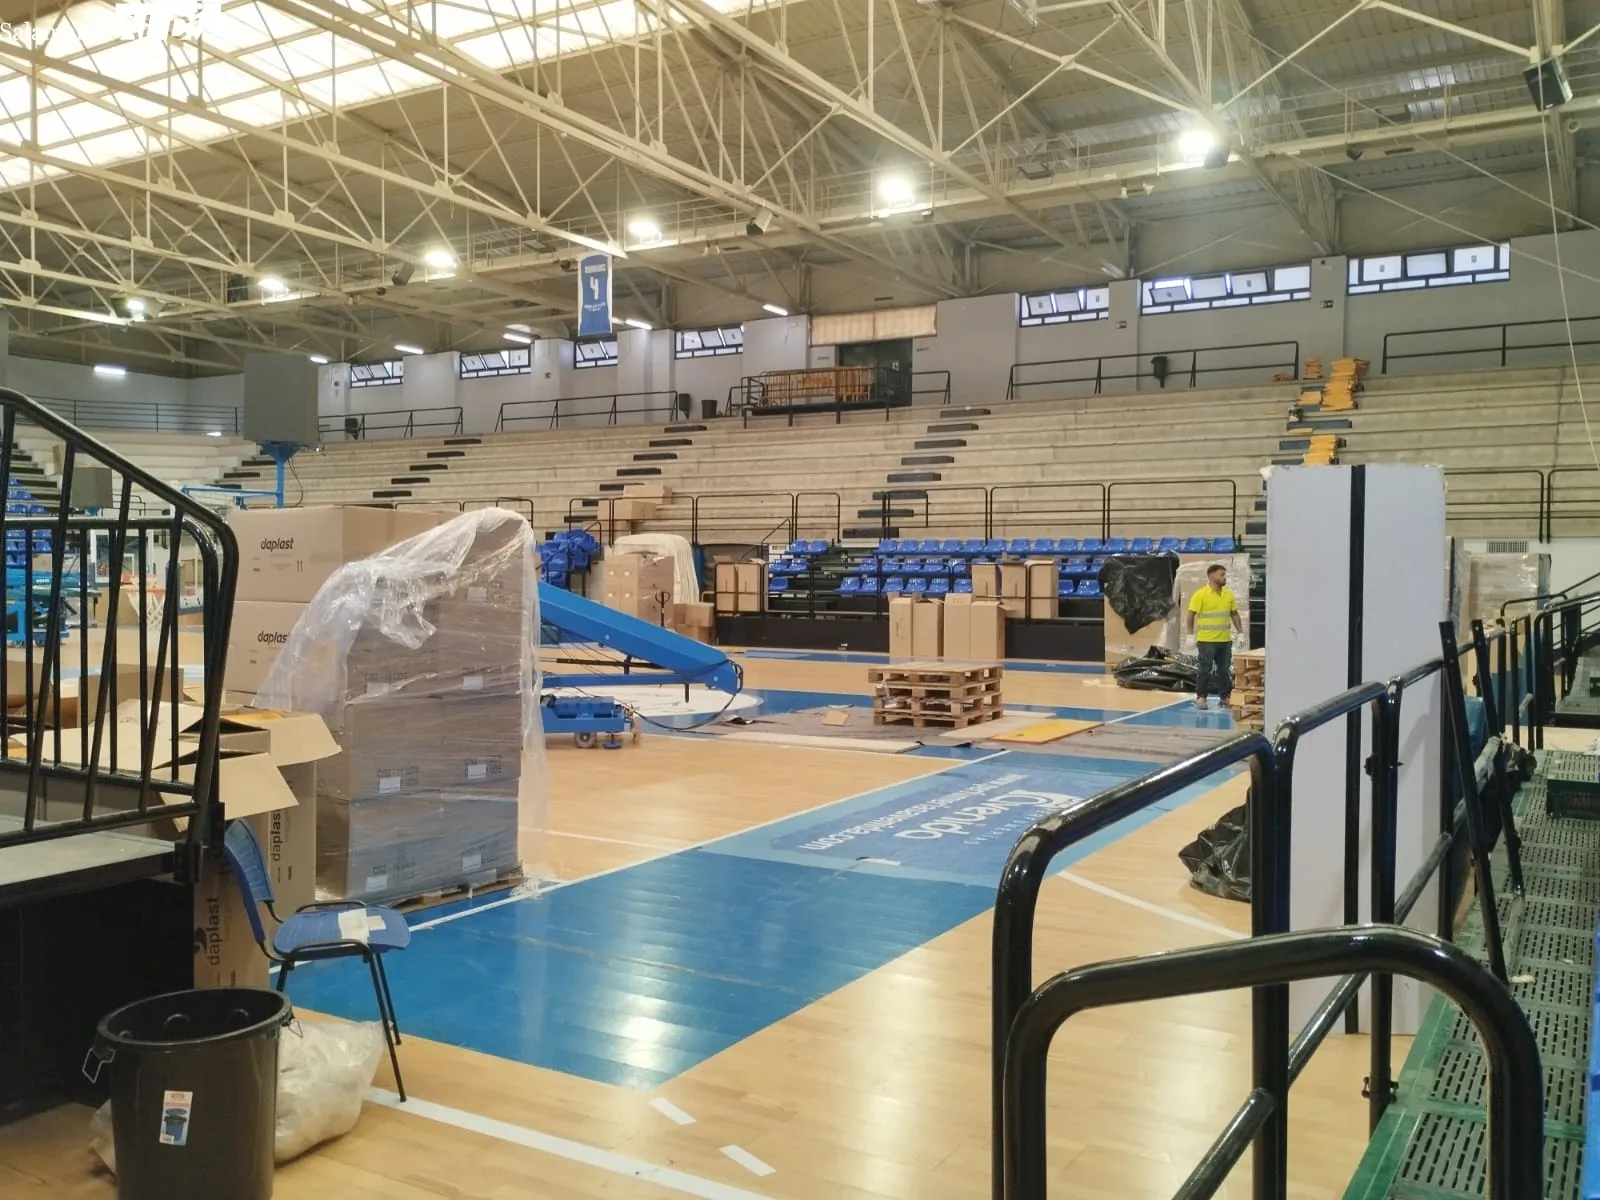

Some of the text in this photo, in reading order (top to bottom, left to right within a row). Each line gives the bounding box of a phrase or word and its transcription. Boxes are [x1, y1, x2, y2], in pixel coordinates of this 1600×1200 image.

[260, 537, 294, 552] daplast
[270, 809, 283, 862] daplas
[205, 896, 222, 966] daplast
